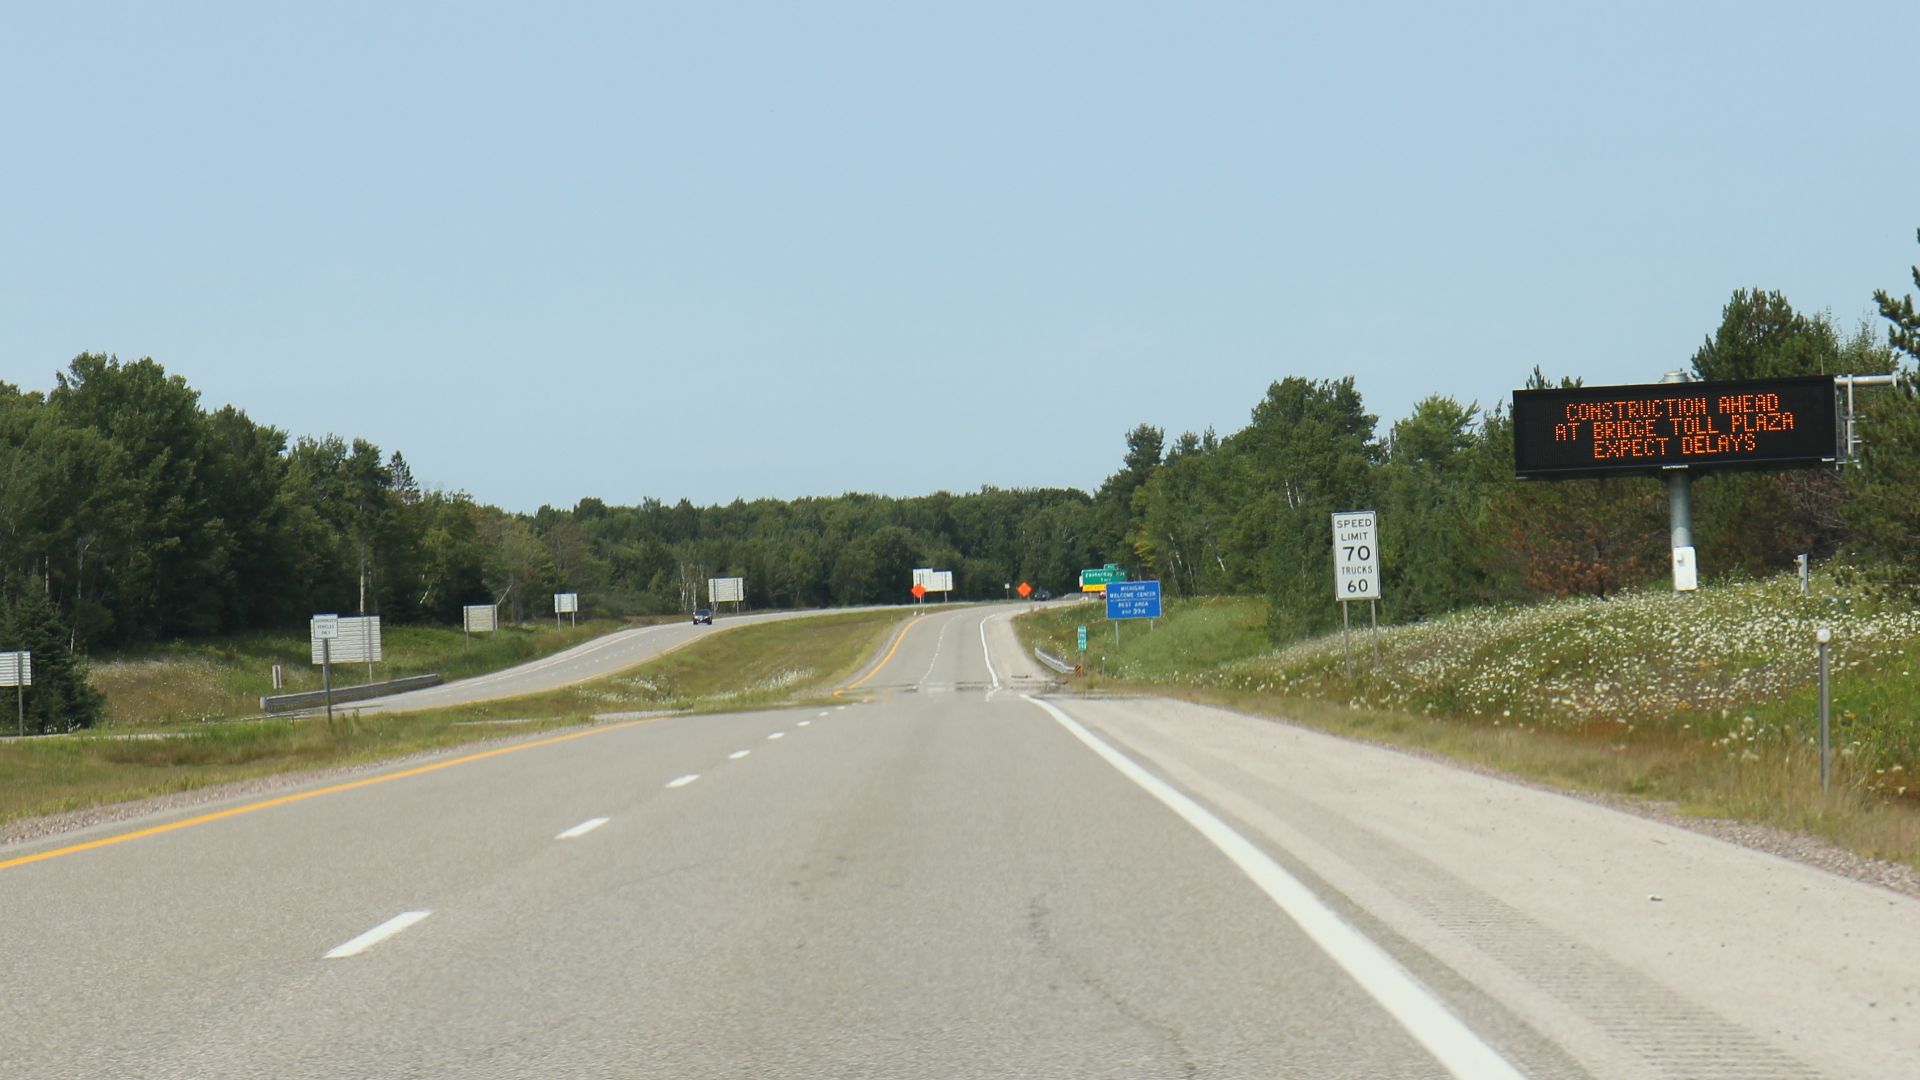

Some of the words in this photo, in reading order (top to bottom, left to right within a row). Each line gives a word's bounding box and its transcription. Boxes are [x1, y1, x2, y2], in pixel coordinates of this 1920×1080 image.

[1565, 397, 1706, 421] CONSTRUCTION
[1718, 393, 1779, 414] AHEAD
[1555, 422, 1580, 441] AT
[1593, 419, 1657, 439] BRIDGE
[1669, 416, 1719, 435] TOLL
[1731, 412, 1794, 432] PLAZA
[1594, 437, 1669, 458] EXPECT
[1682, 433, 1756, 454] DELAYS
[1337, 518, 1372, 529] SPEED
[1341, 532, 1368, 542] LIMIT
[1343, 545, 1370, 561] 70
[1341, 565, 1373, 575] TRUCKS
[1347, 578, 1368, 593] 60
